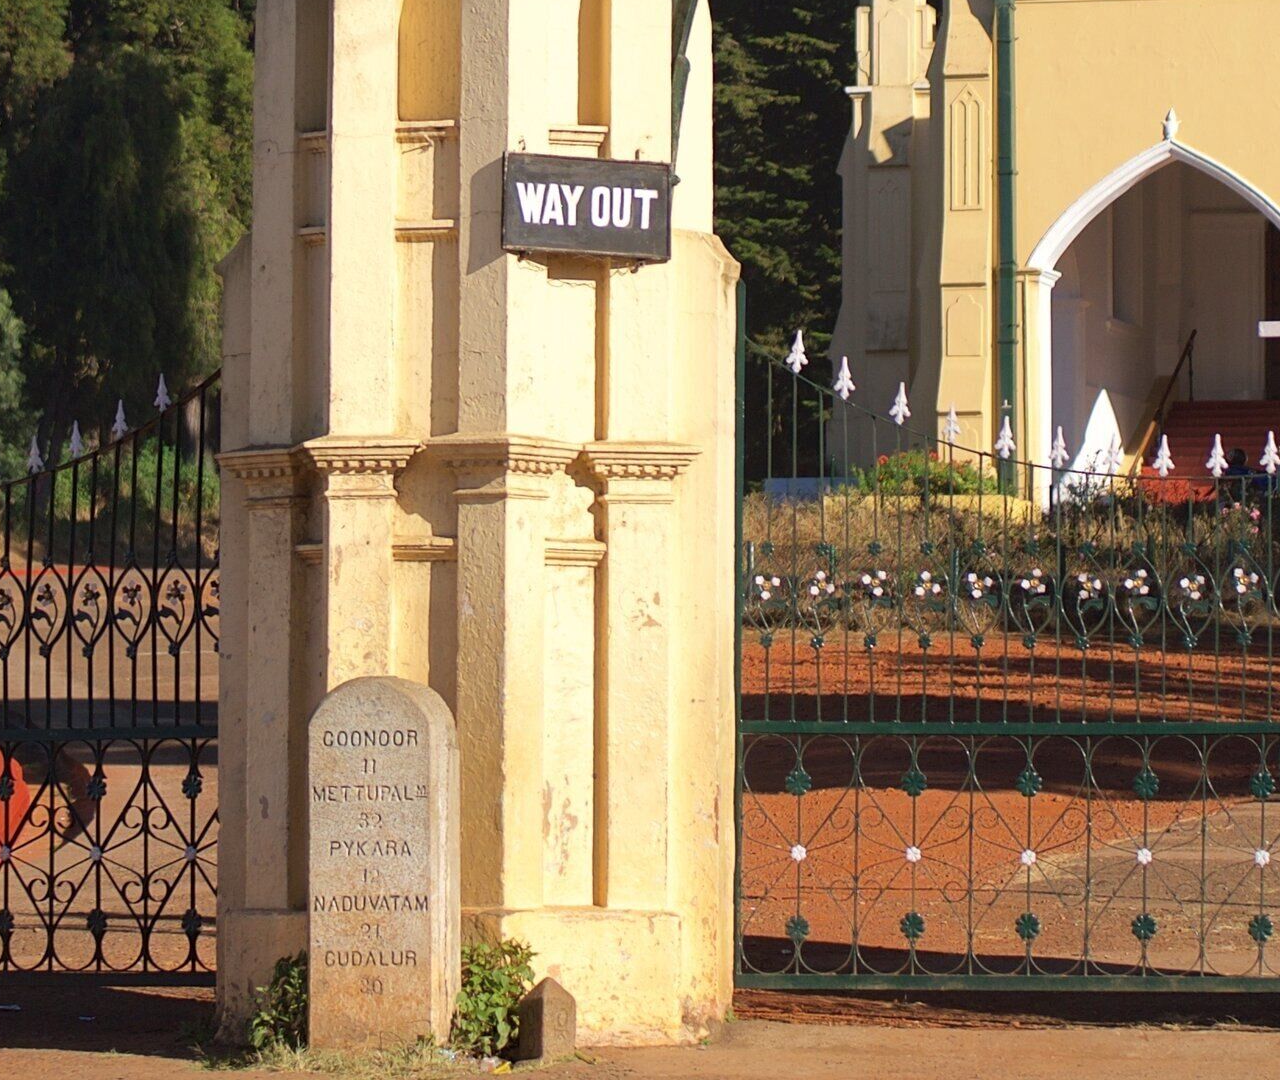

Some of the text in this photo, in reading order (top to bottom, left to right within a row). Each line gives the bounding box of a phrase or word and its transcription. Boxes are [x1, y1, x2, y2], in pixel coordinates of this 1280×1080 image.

[516, 182, 659, 230] WAY OUT
[323, 729, 418, 747] COONOOR
[363, 758, 377, 774] 11
[330, 840, 412, 857] PYKARA
[314, 895, 429, 911] NADUVATAM
[325, 950, 417, 967] GUDALUR
